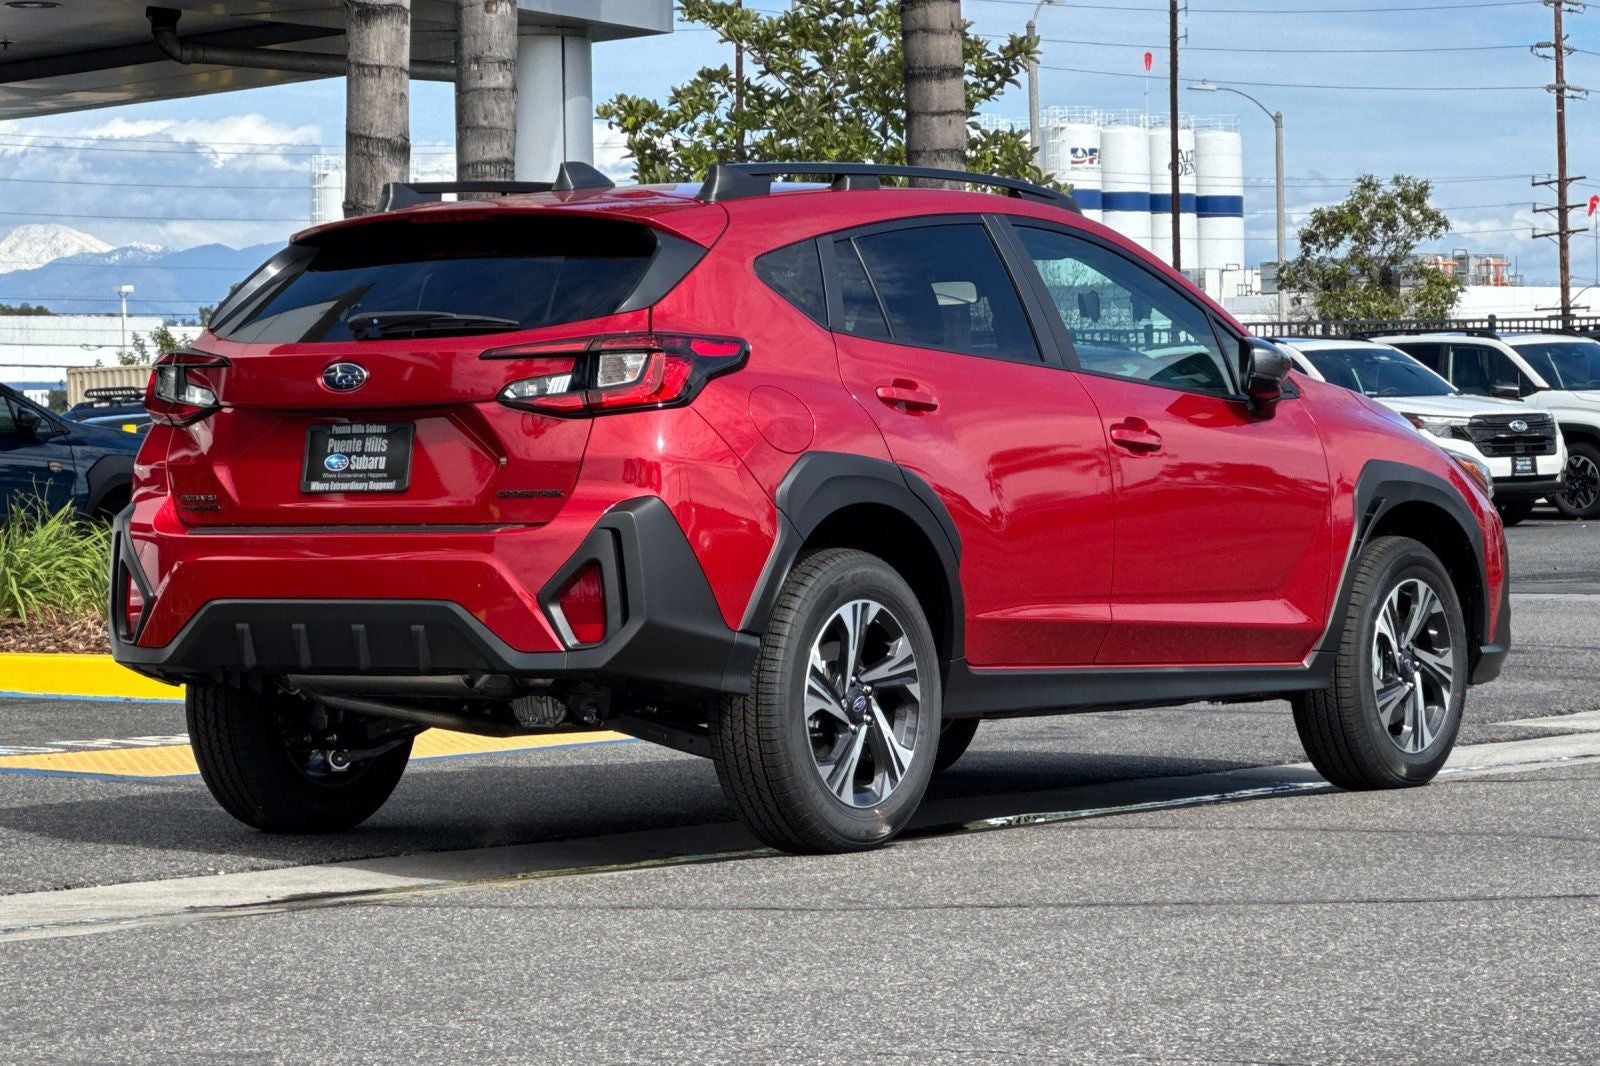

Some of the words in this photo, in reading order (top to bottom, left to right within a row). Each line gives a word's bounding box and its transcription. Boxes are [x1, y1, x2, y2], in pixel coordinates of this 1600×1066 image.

[1070, 147, 1100, 165] DF
[332, 425, 351, 434] Puente
[352, 425, 365, 434] Hills
[365, 424, 387, 433] Subaru
[327, 438, 362, 453] Puente
[364, 437, 388, 452] Hills
[350, 455, 386, 470] Subaru
[310, 481, 330, 491] Where
[330, 481, 369, 491] Extraordinary
[369, 480, 396, 491] Happens!
